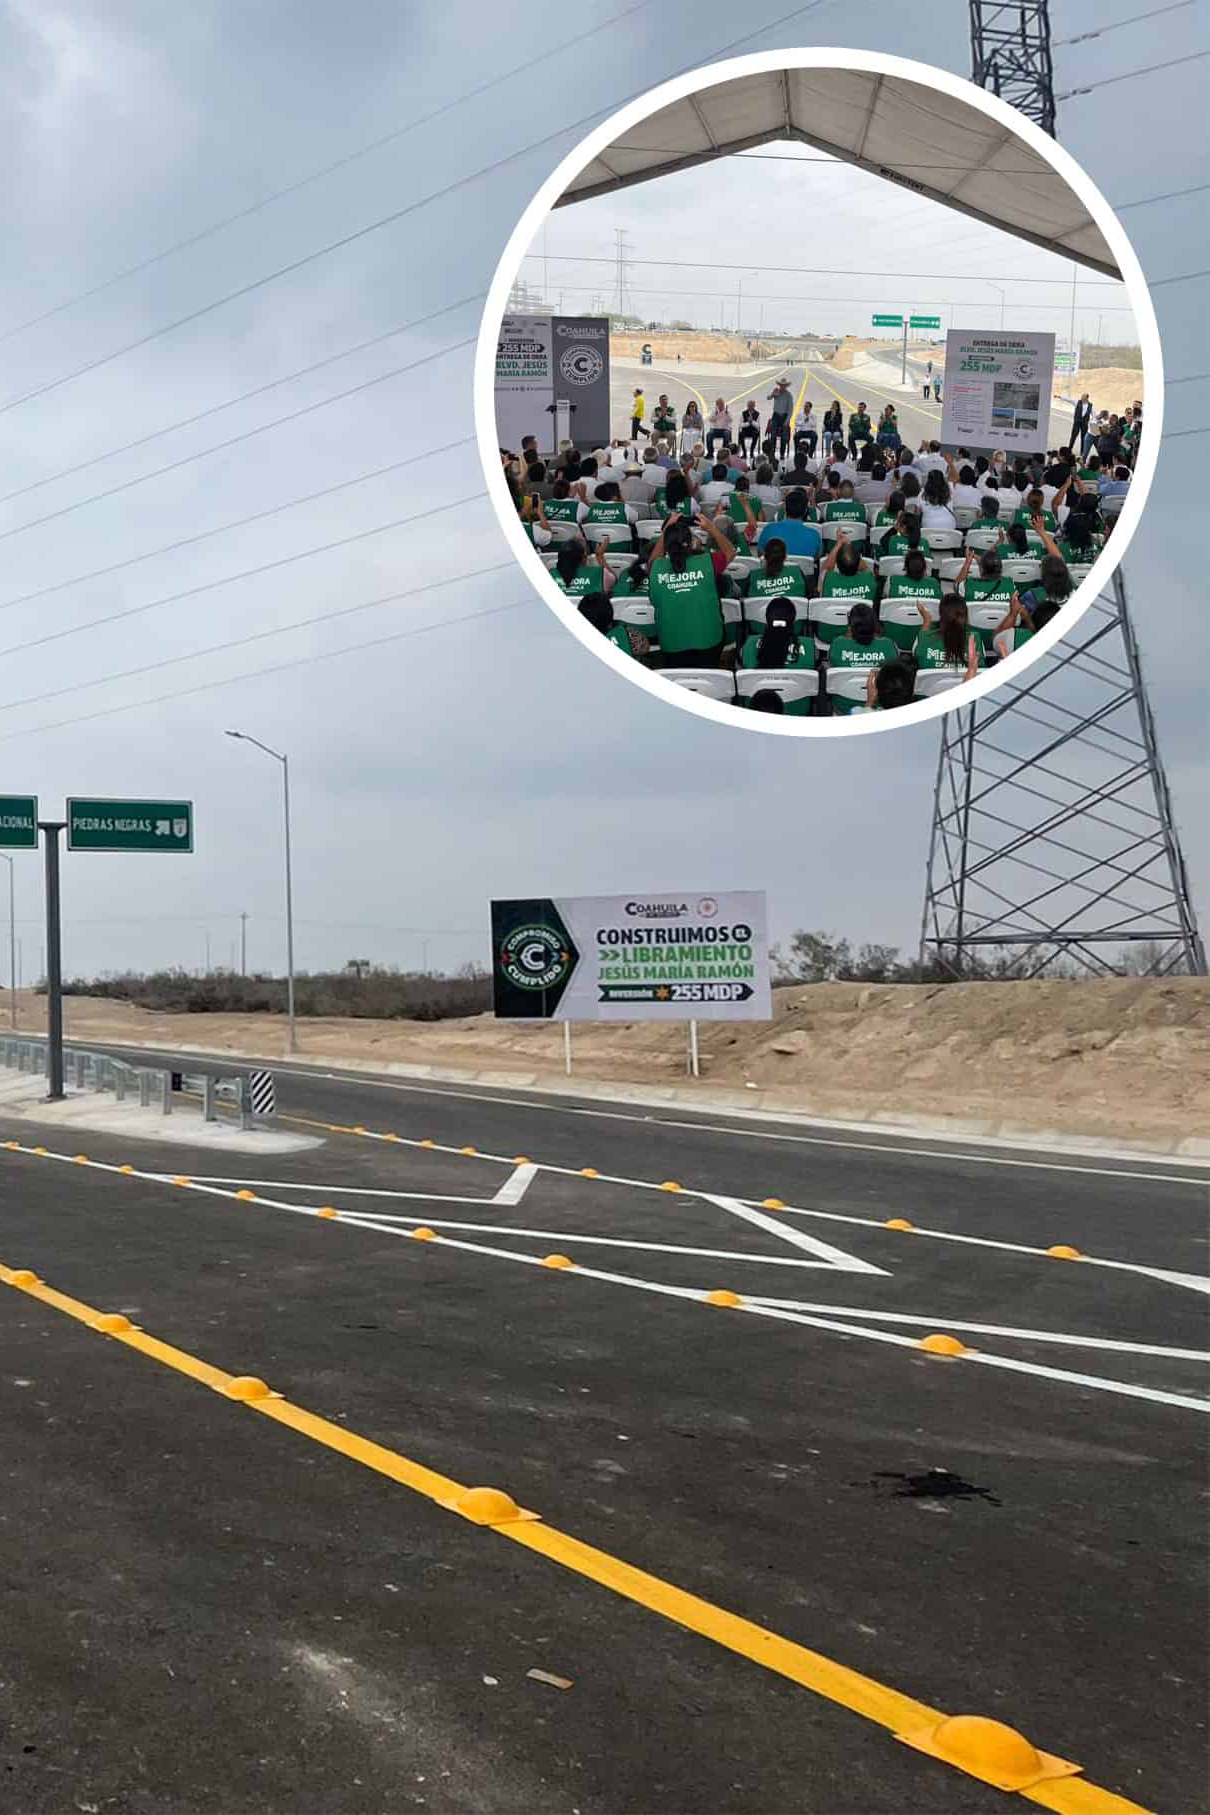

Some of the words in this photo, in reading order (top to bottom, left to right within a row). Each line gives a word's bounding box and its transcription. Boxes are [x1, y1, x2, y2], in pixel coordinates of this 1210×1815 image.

[502, 343, 519, 352] 255
[520, 344, 541, 353] MDP
[959, 361, 980, 371] 255
[656, 570, 704, 584] MEJORA
[756, 576, 795, 590] MEJORA
[831, 585, 871, 597] MEJORA
[898, 584, 935, 596] MEJORA
[841, 650, 886, 661] MEJORA
[72, 817, 114, 831] PIEDRAS
[114, 818, 152, 832] NEGRAS
[624, 902, 688, 916] COAHUILA
[507, 929, 561, 950] COMPROMISO
[596, 926, 730, 945] CONSTRUIMOS
[621, 944, 753, 963] LIBRAMIENTO
[507, 964, 562, 986] CUMPLIDO
[598, 963, 640, 980] JESÚS
[644, 962, 694, 979] MARÍA
[697, 961, 755, 978] RAMÓN
[670, 985, 702, 1001] 255
[703, 983, 744, 1001] MDP
